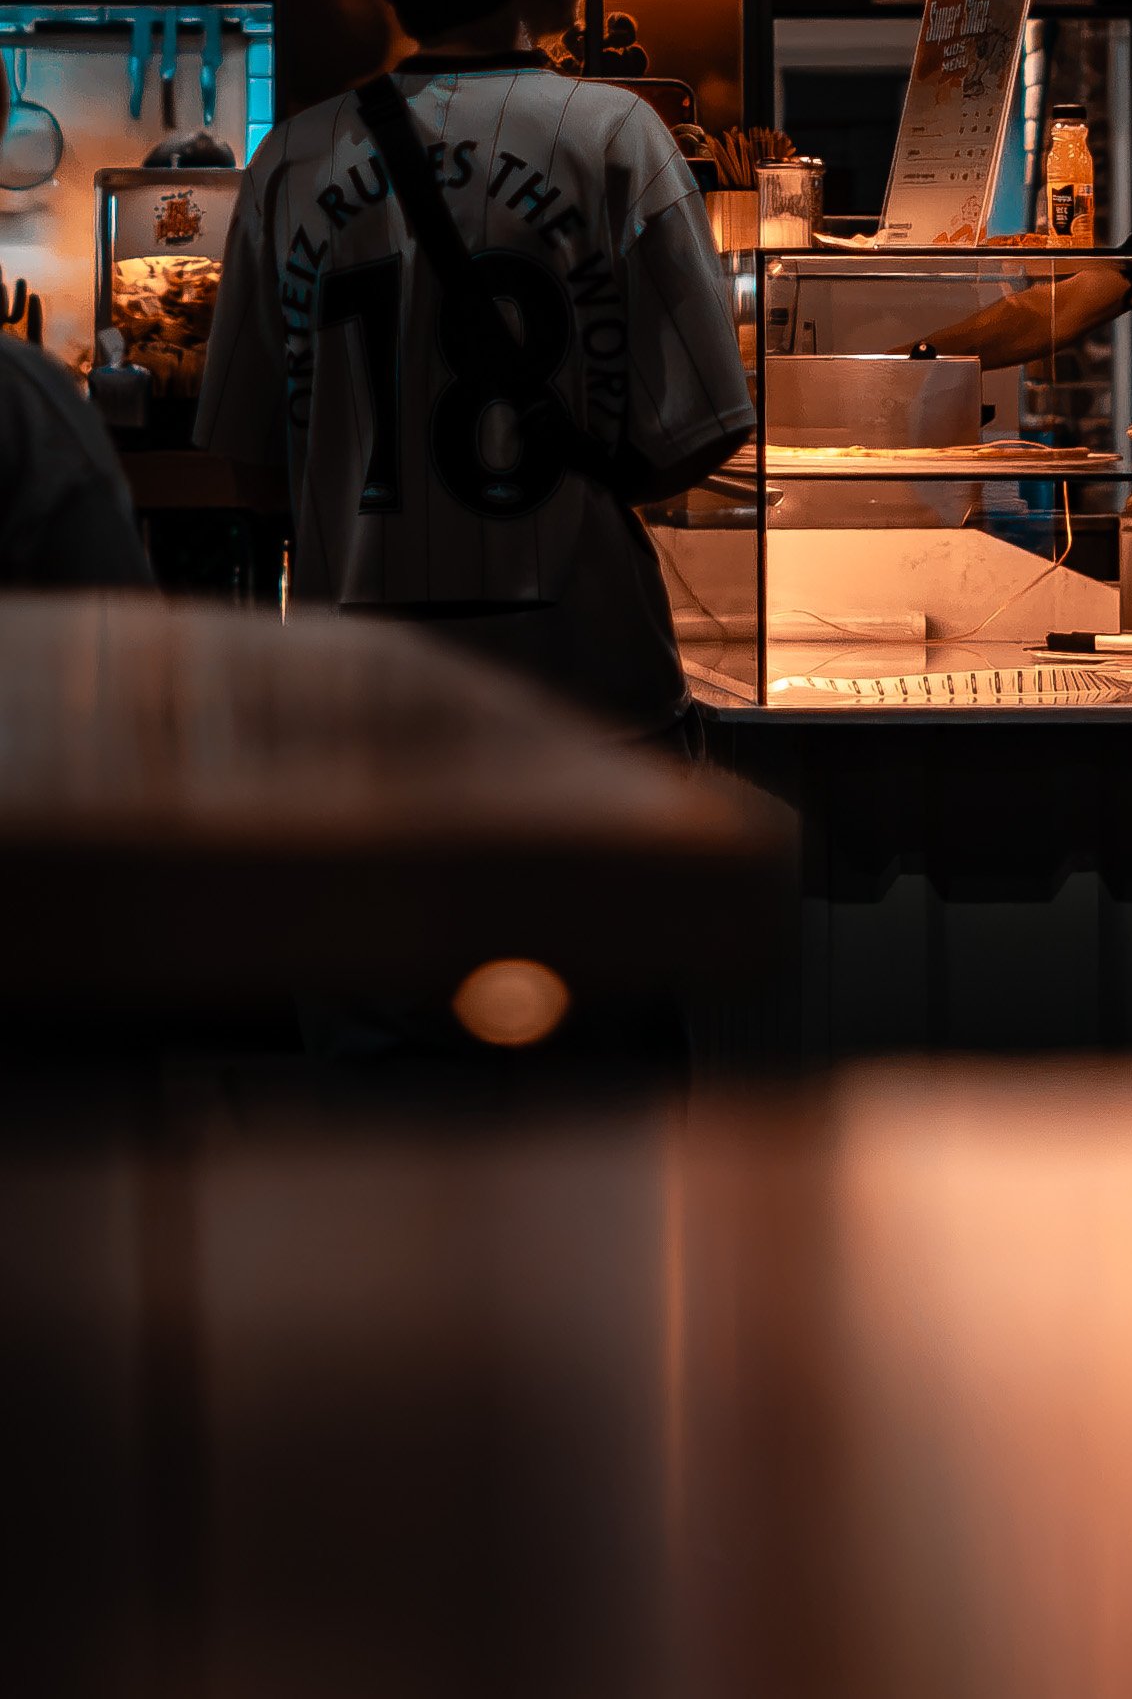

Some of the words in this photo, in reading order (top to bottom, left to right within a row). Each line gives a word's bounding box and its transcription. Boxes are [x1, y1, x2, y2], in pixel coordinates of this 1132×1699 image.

[316, 139, 478, 231] RUES
[487, 150, 587, 250] THE
[566, 251, 627, 430] WOR
[318, 250, 574, 520] 18
